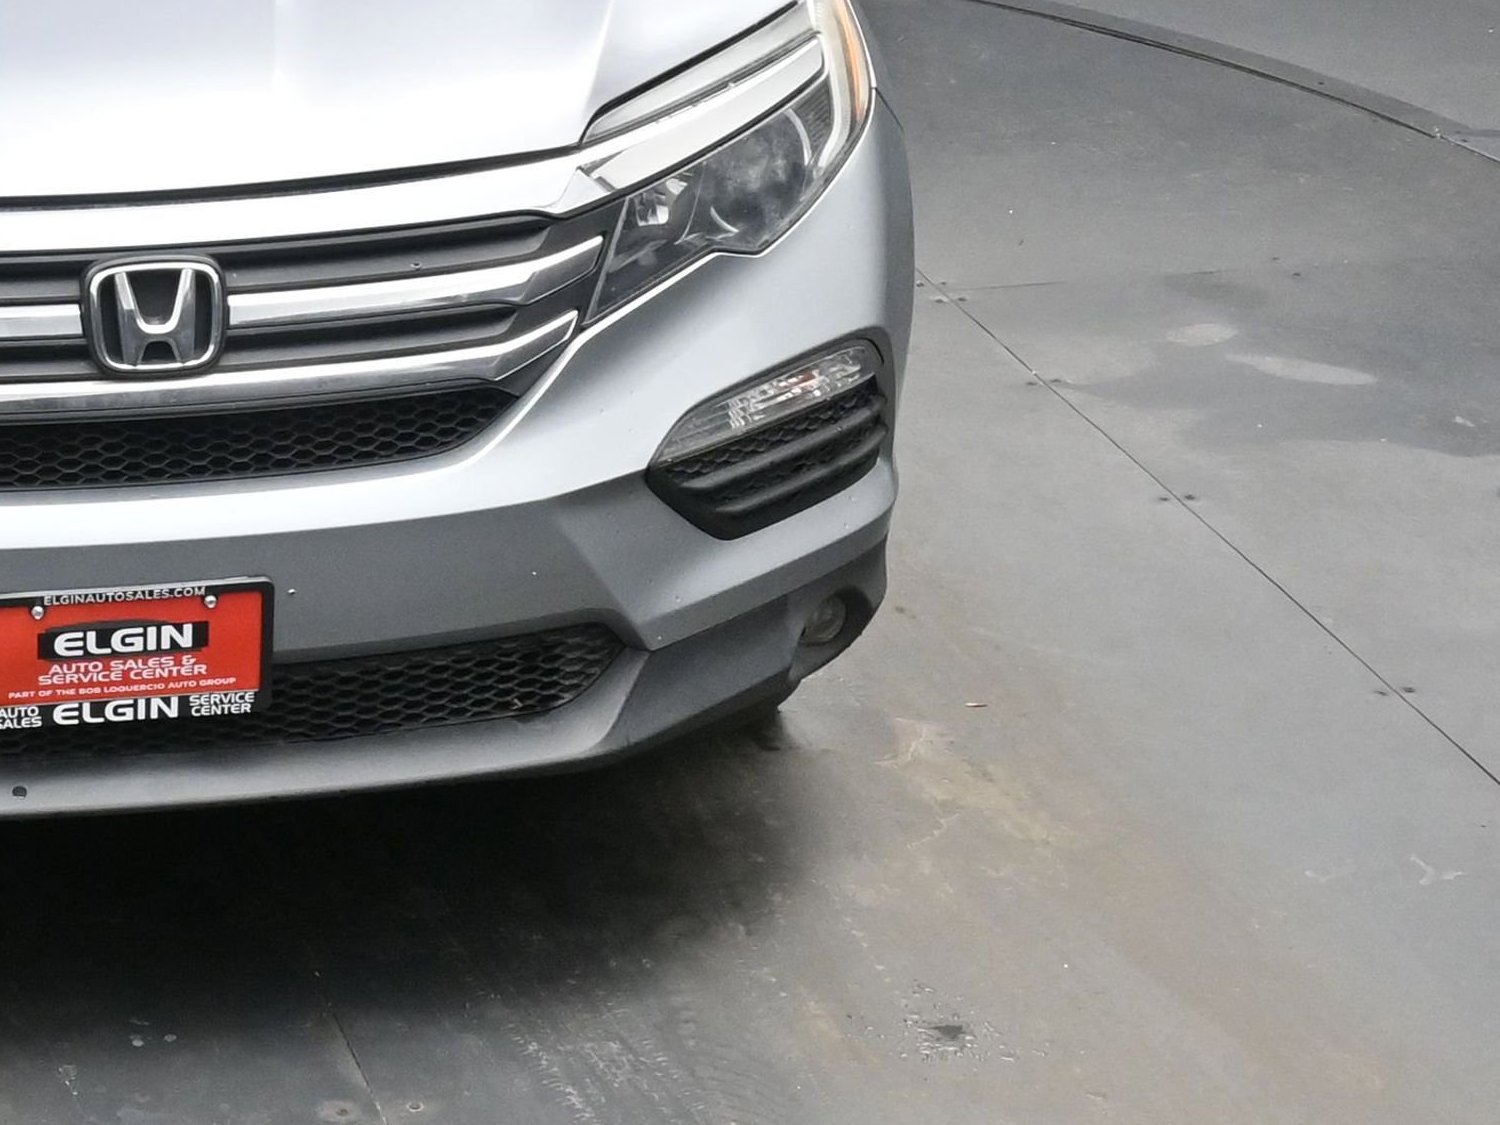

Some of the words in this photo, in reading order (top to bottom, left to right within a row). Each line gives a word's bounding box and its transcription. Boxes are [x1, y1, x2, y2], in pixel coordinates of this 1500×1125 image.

[43, 586, 206, 606] ELGINAUTOSALES.COM
[53, 623, 193, 657] ELGIN
[38, 671, 123, 685] SERVICE
[130, 665, 207, 680] CENTER
[48, 661, 103, 675] AUTO
[110, 656, 175, 670] SALES
[8, 690, 35, 699] PART
[56, 688, 75, 696] THE
[79, 686, 101, 695] BOB
[103, 683, 165, 693] LOQUERCIO
[168, 680, 197, 689] AUTO
[199, 677, 237, 686] GROUP
[189, 691, 255, 706] SERVICE
[52, 696, 179, 725] ELGIN
[191, 702, 252, 716] CENTER
